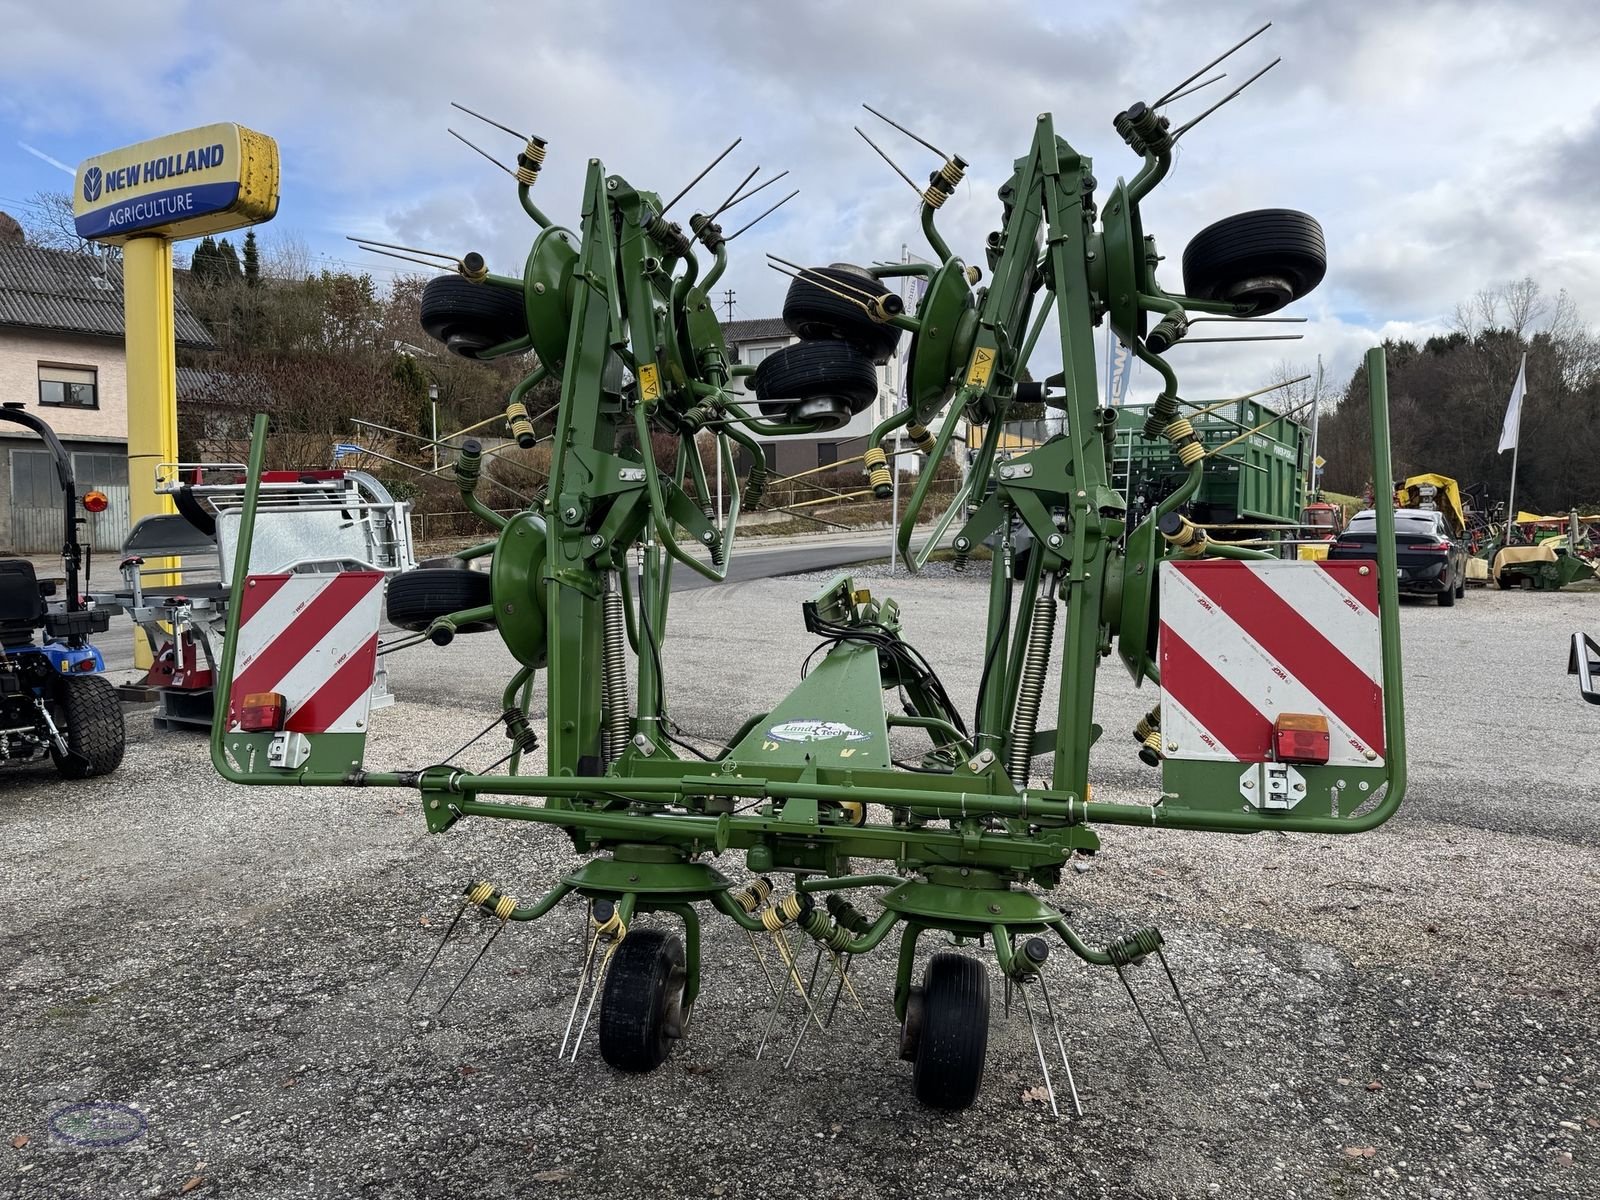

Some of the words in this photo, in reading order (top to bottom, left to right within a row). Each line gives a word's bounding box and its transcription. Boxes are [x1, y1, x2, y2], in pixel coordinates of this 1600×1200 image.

[105, 164, 141, 193] NEW
[144, 144, 224, 183] HOLLAND
[108, 192, 193, 227] AGRICULTURE
[1197, 598, 1212, 611] WGF
[1343, 598, 1359, 611] WGF
[1271, 666, 1287, 680] WGF
[1199, 733, 1215, 747] WGF
[1348, 738, 1364, 753] WGF
